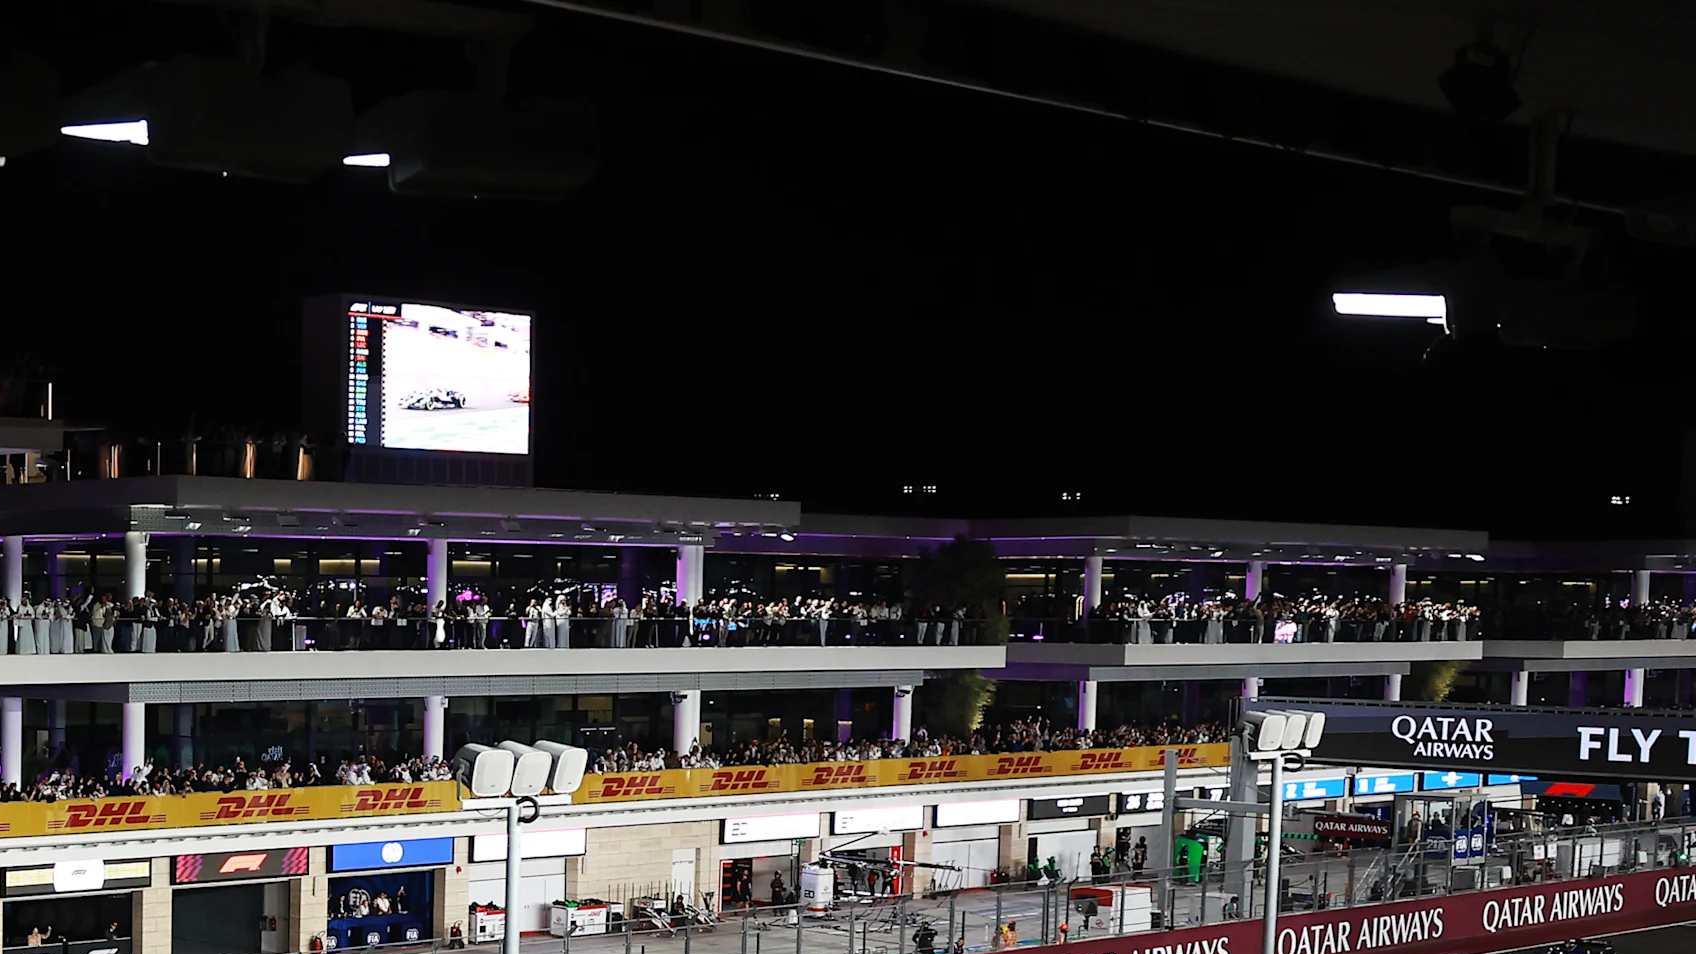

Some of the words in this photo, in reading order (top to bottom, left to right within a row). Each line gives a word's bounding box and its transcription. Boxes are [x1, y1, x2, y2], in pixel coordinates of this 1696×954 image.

[1391, 714, 1495, 744] QATAR
[1413, 741, 1495, 760] AIRWAYS
[1577, 726, 1663, 764] FLY
[907, 760, 958, 779] DHL
[996, 756, 1044, 774] DHL
[1079, 752, 1124, 770] DHL
[710, 770, 769, 790] DHL
[812, 765, 867, 784] DHL
[601, 775, 664, 797] DHL
[215, 794, 296, 819] DHL
[355, 788, 428, 811] DHL
[65, 802, 151, 828] DHL
[1315, 821, 1346, 832] QATAR
[1347, 823, 1389, 835] AIRWAYS
[1471, 837, 1483, 848] FIA
[219, 853, 268, 874] F1
[1482, 894, 1545, 932] QATAR
[1549, 882, 1624, 922] AIRWAYS
[406, 930, 418, 939] FIA
[1356, 907, 1444, 950] AIRWAYS
[367, 935, 379, 944] FIA
